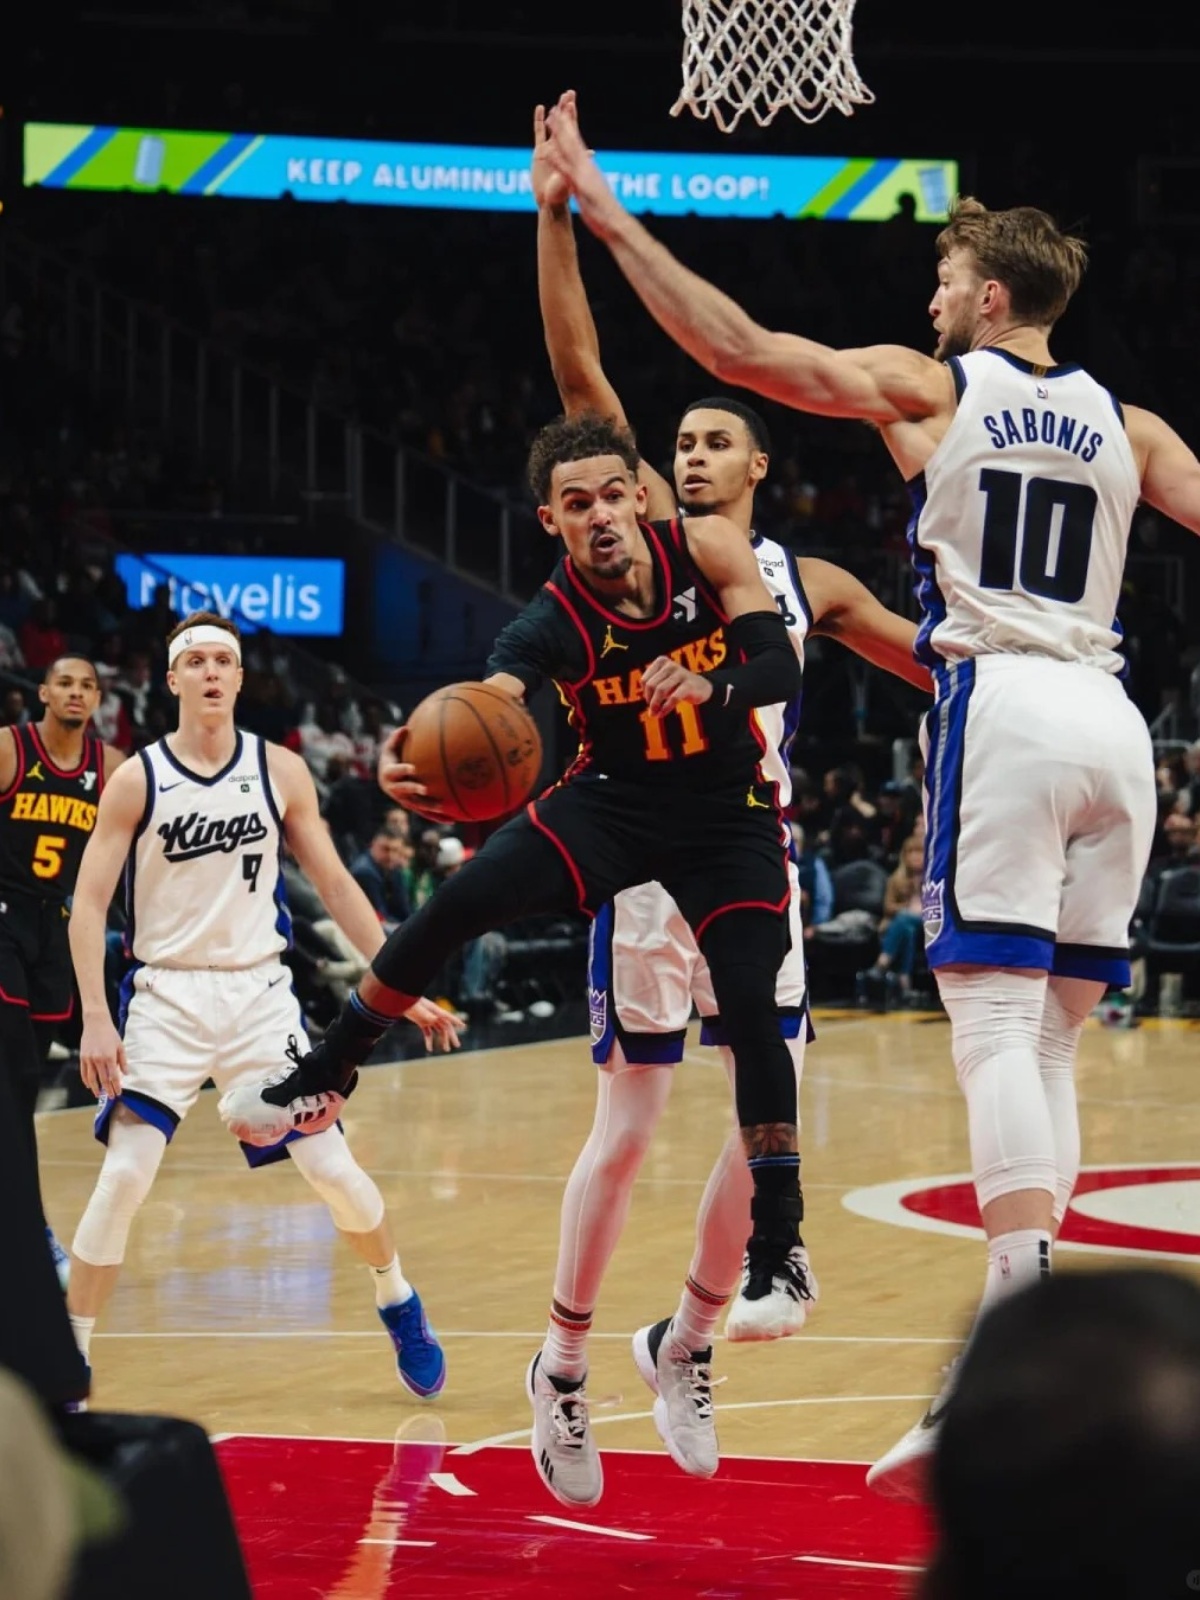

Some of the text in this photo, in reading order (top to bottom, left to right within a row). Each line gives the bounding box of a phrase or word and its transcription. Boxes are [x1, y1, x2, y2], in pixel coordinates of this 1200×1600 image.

[286, 158, 362, 186] KEEP
[603, 172, 661, 198] THE
[671, 174, 770, 200] LOOP!
[983, 408, 1104, 463] SABONIS
[979, 467, 1099, 604] 10
[639, 698, 706, 761] 11
[10, 792, 99, 832] HAWKS
[31, 834, 67, 879] 5
[157, 812, 268, 862] Kings
[242, 853, 263, 893] 9
